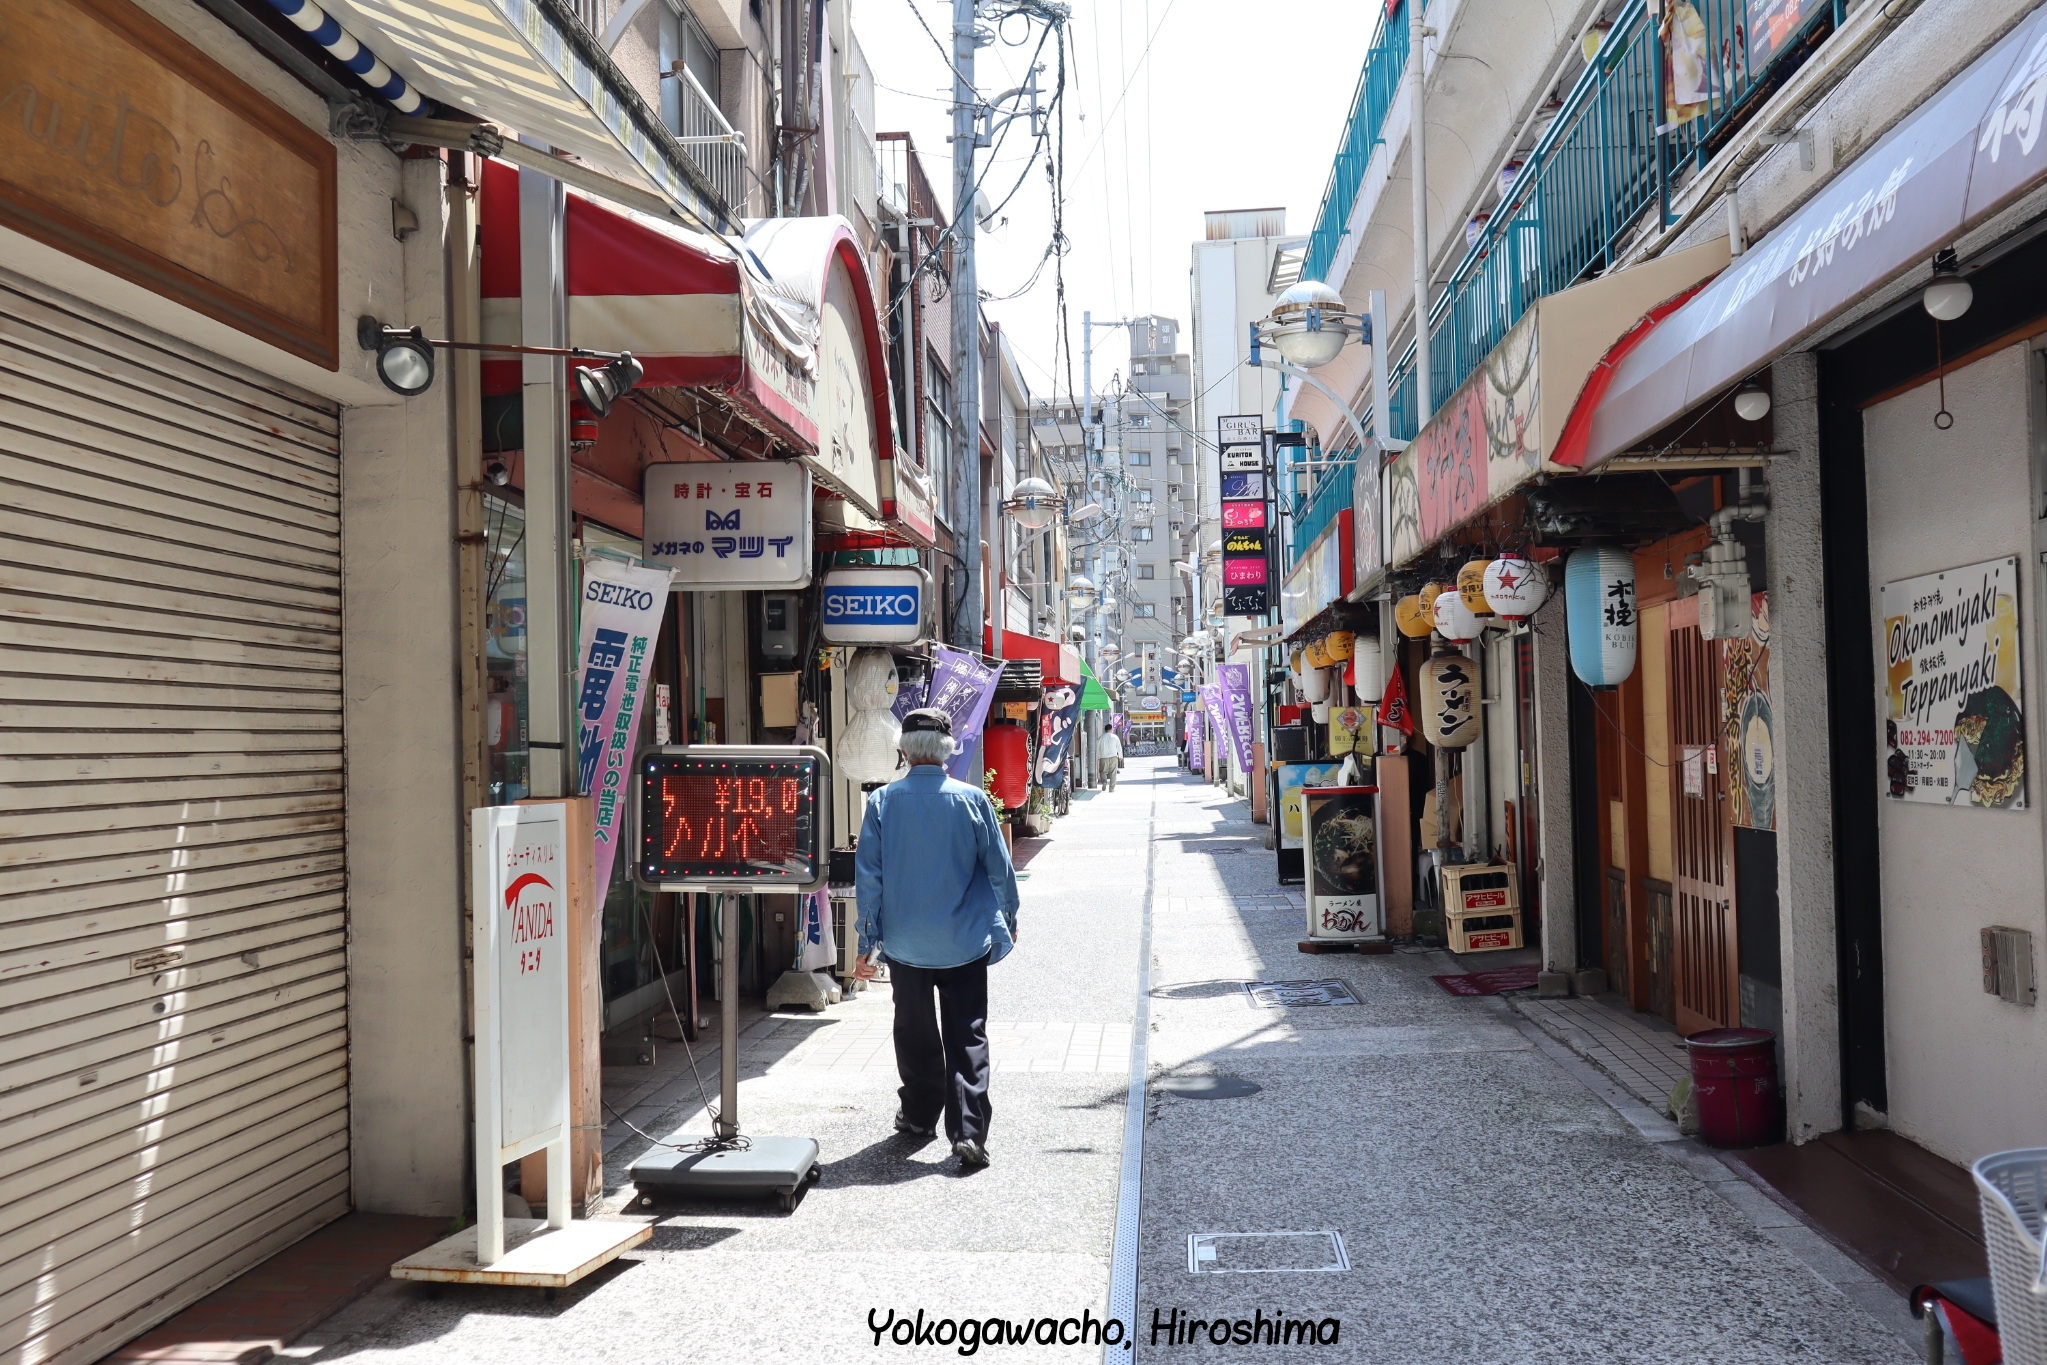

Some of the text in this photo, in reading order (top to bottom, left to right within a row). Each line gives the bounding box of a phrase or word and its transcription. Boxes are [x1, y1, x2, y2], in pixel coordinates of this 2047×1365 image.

[1789, 157, 1914, 288] お好み焼
[1226, 421, 1256, 429] GIRL'S
[674, 482, 773, 499] 時計・宝石
[652, 541, 704, 556] メガネの
[1226, 540, 1262, 551] のんちゃん
[1230, 571, 1262, 580] ひまわり
[586, 580, 653, 611] SEIKO
[826, 594, 916, 617] SEIKO
[1913, 588, 1944, 613] お好み焼
[1890, 568, 1999, 665] Okonomiyaki
[1611, 641, 1635, 649] BLUE
[1902, 637, 1999, 727] Teppanyaki
[1437, 663, 1474, 736] ラーメン
[594, 635, 648, 845] 純正電池取扱いの当店へ
[1900, 729, 1954, 746] 082-294-7200
[506, 844, 554, 867] ビューティスリム
[1328, 899, 1362, 907] ラーメン屋
[1466, 891, 1505, 902] アサヒビール
[505, 873, 556, 950] TANIDA
[1321, 908, 1370, 932] おかん
[1470, 933, 1508, 942] アサヒビール
[520, 947, 541, 975] タニダ
